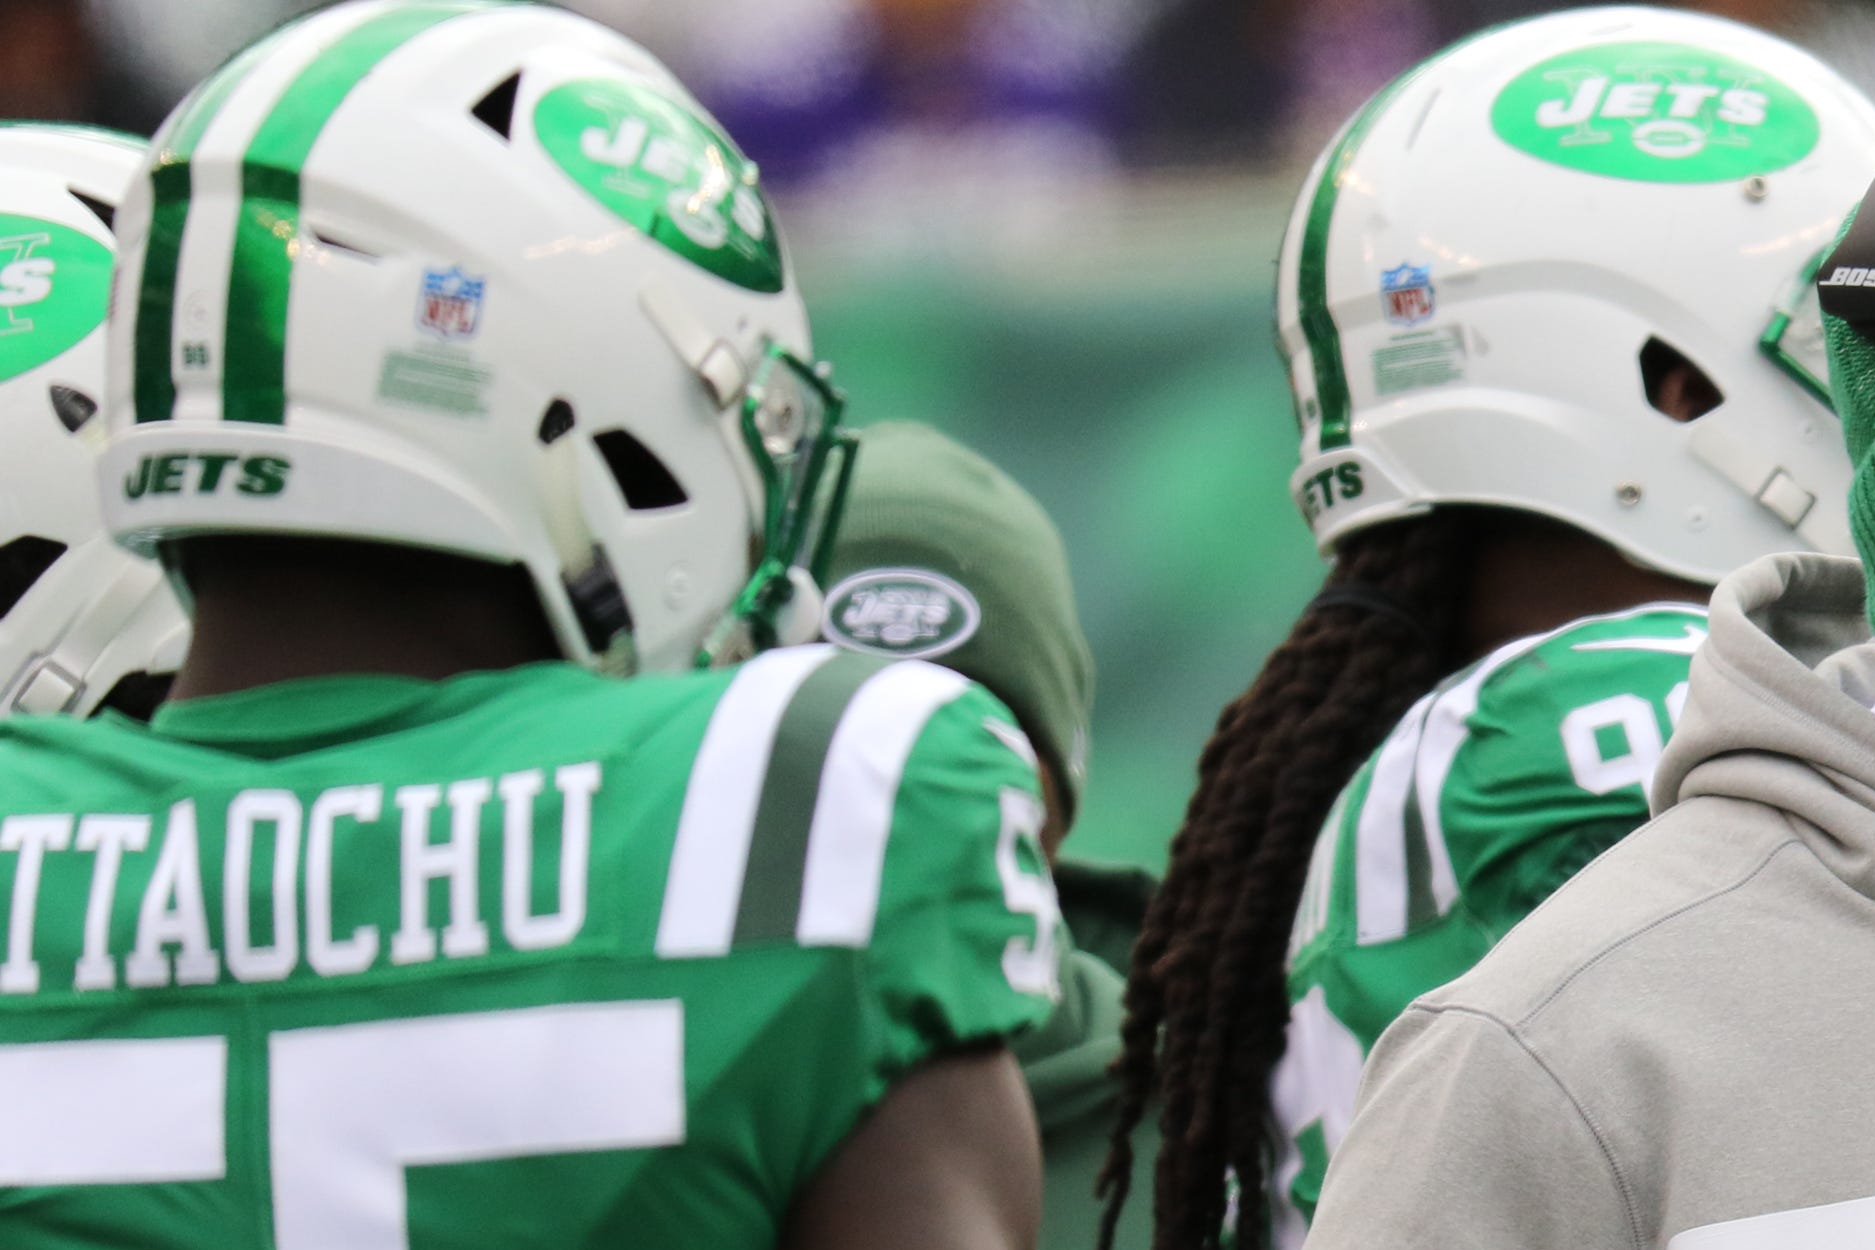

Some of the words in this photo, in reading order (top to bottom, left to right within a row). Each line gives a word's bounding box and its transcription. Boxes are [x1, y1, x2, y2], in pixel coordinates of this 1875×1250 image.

[1535, 76, 1770, 128] JETS
[125, 454, 291, 500] JETS
[0, 760, 600, 994] TTAOCHU
